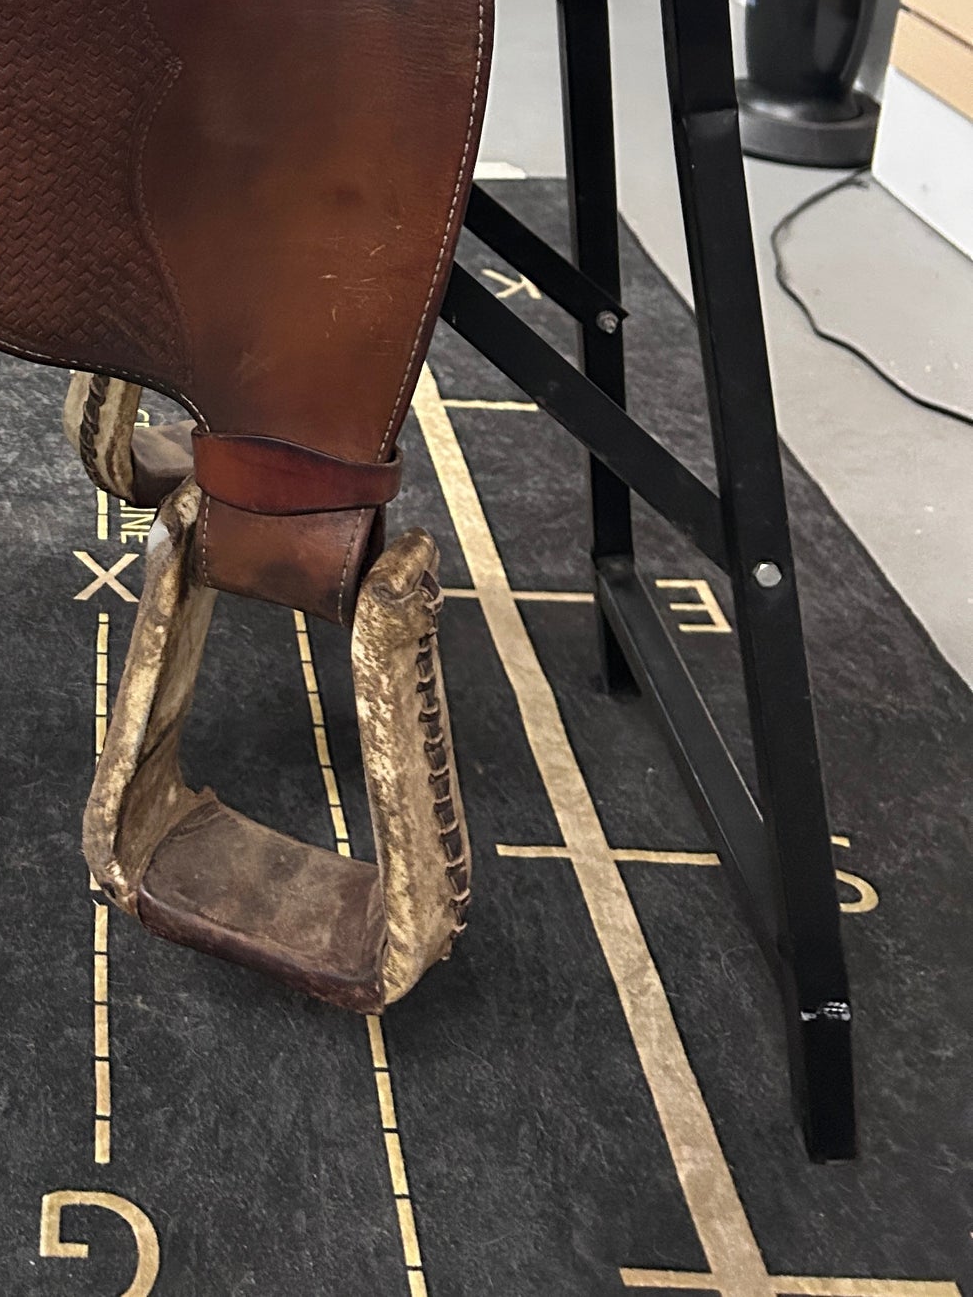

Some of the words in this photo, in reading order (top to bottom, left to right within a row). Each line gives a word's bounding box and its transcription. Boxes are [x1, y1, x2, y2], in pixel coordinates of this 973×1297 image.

[120, 500, 157, 544] INE
[72, 551, 140, 603] X
[655, 579, 732, 633] E
[39, 1190, 160, 1297] G
